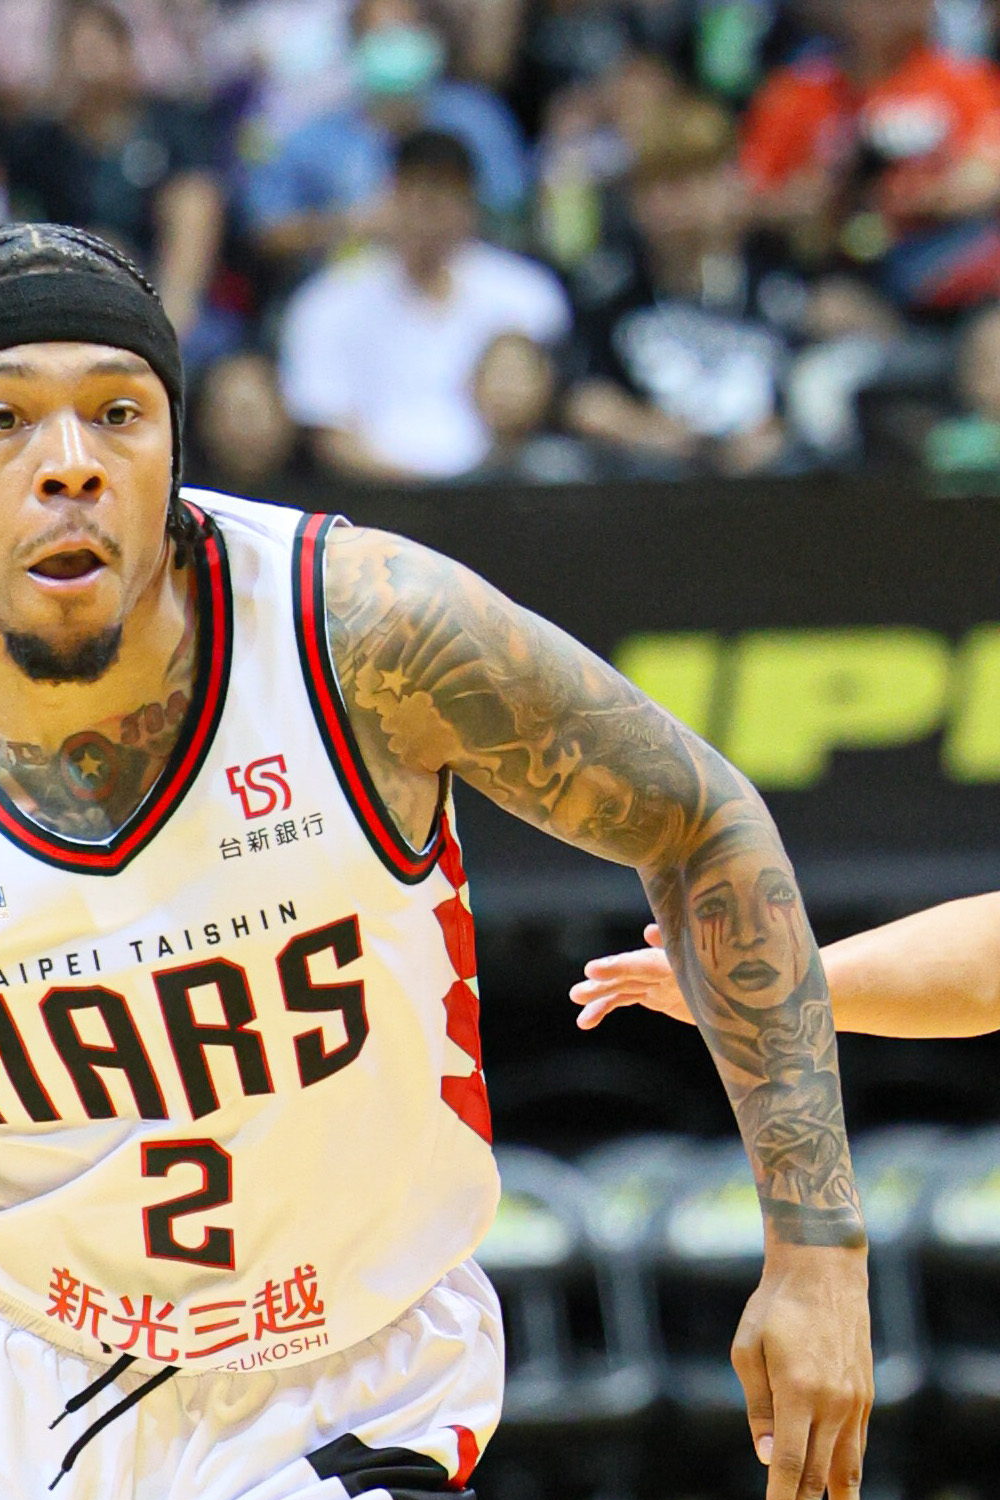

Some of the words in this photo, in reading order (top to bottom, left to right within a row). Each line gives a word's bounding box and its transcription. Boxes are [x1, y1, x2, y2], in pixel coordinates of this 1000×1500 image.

[219, 812, 323, 860] 台新銀行
[129, 900, 297, 963] TAISHIN
[140, 1138, 236, 1271] 2
[45, 1264, 326, 1362] 新光三越
[211, 1332, 330, 1373] SUKOSHI
